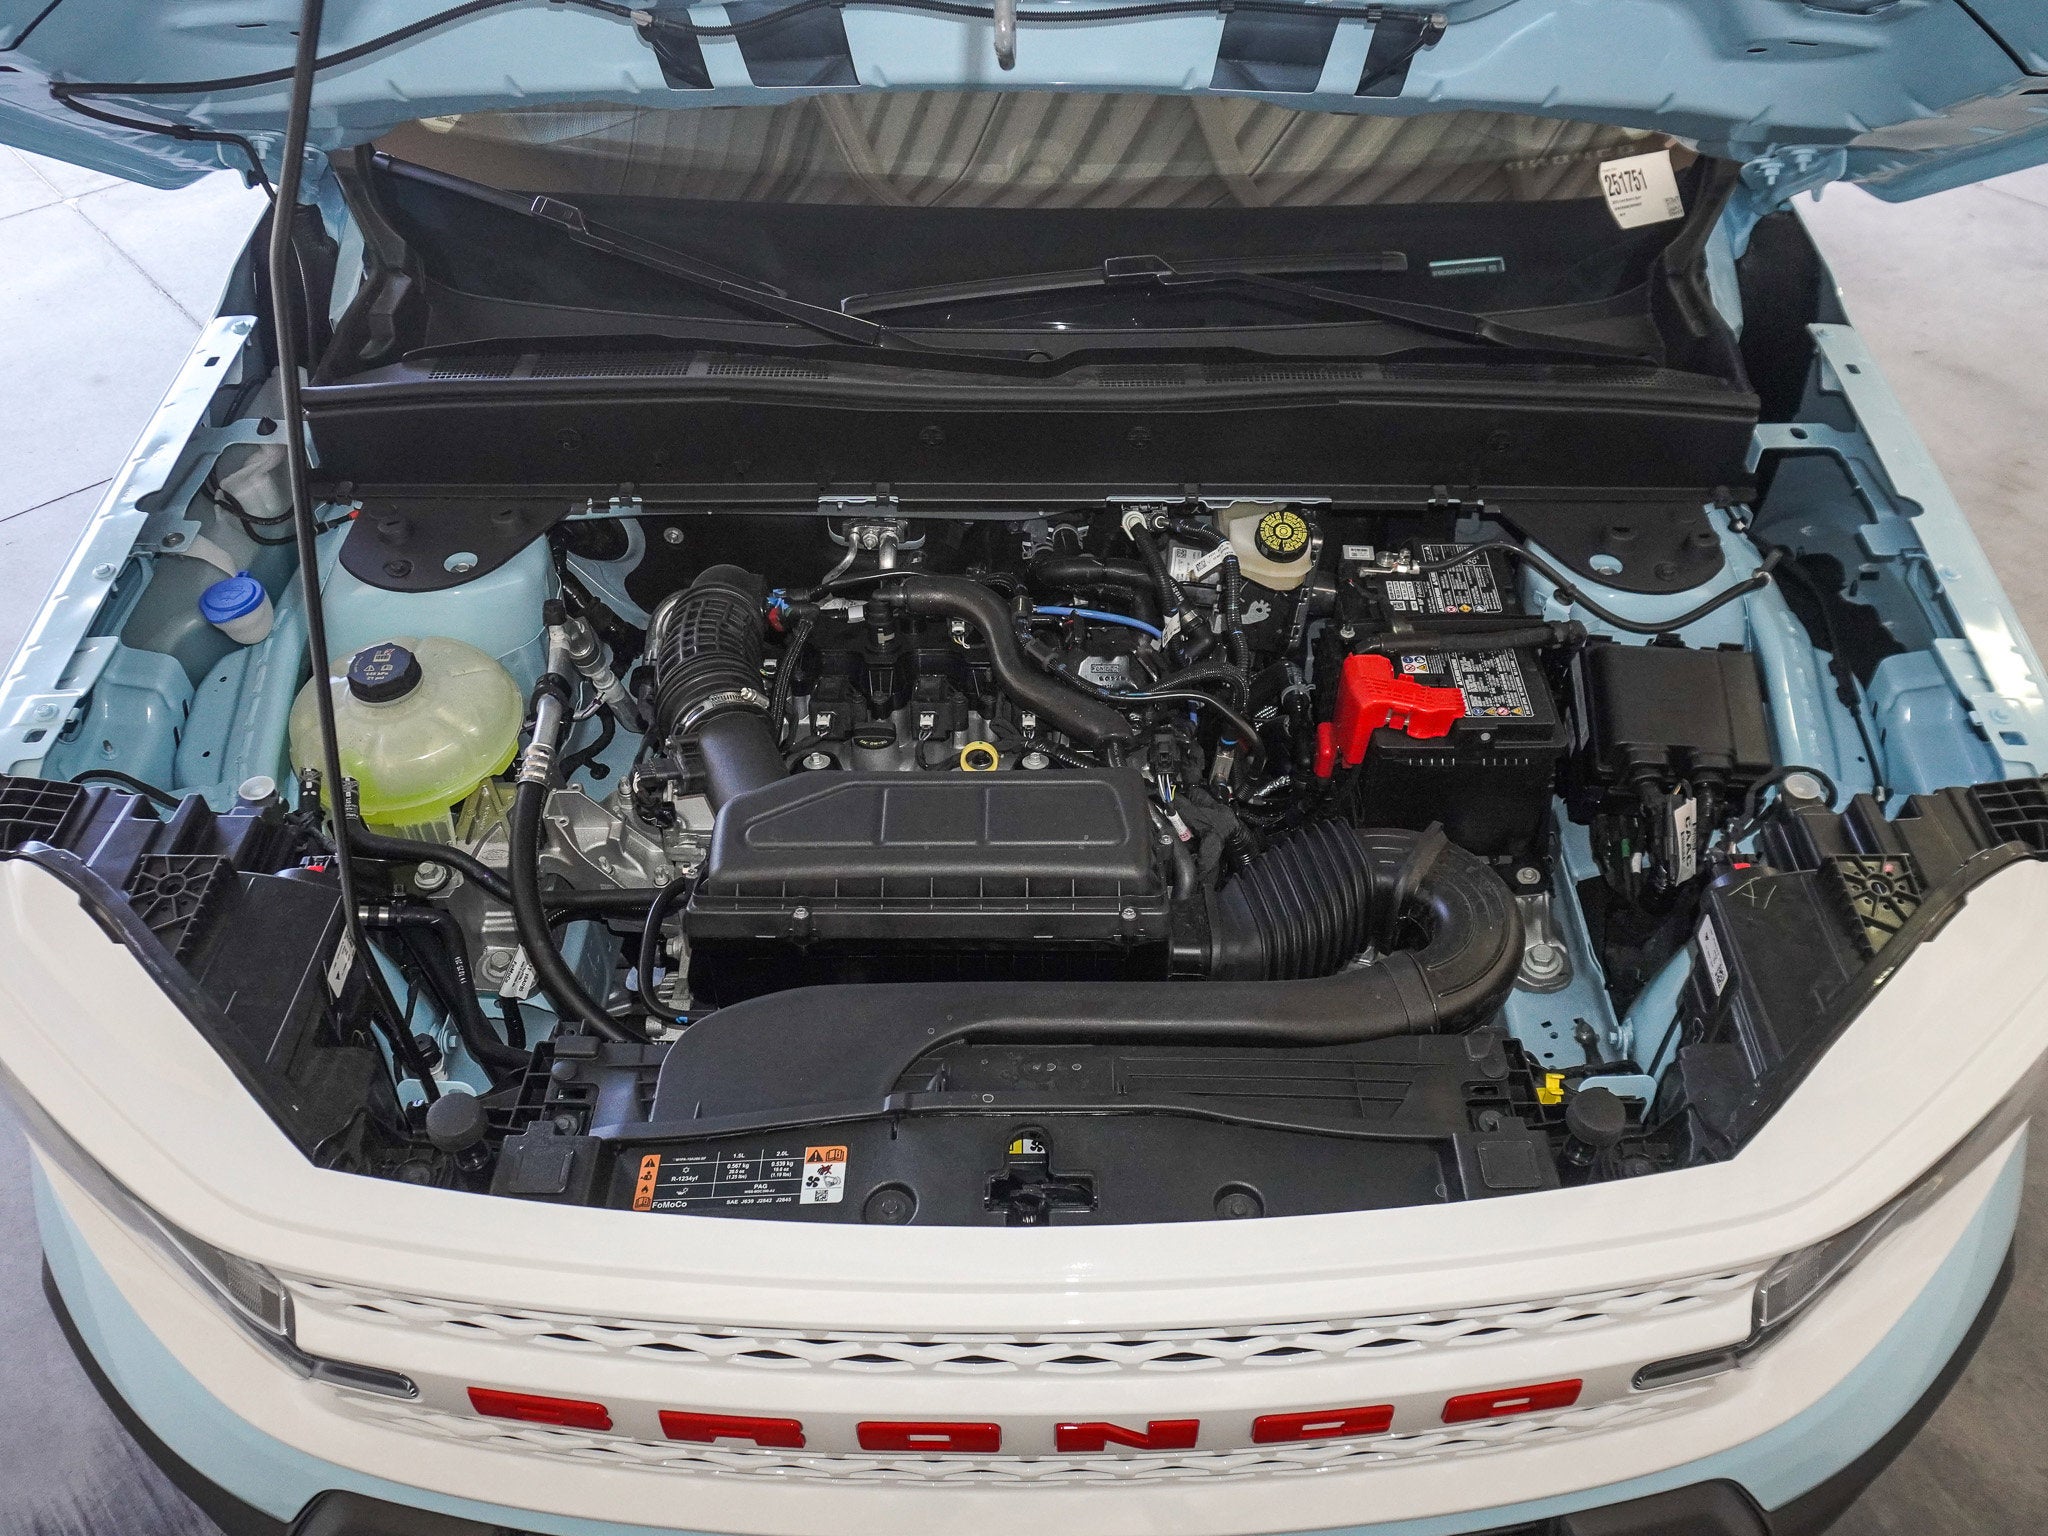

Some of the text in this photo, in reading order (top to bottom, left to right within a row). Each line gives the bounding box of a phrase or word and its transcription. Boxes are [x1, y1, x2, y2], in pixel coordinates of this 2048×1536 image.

[1604, 167, 1648, 197] 251751
[671, 1175, 699, 1183] R-1234yf
[652, 1200, 688, 1209] FoMoCo
[467, 1378, 1583, 1453] BRONCO
